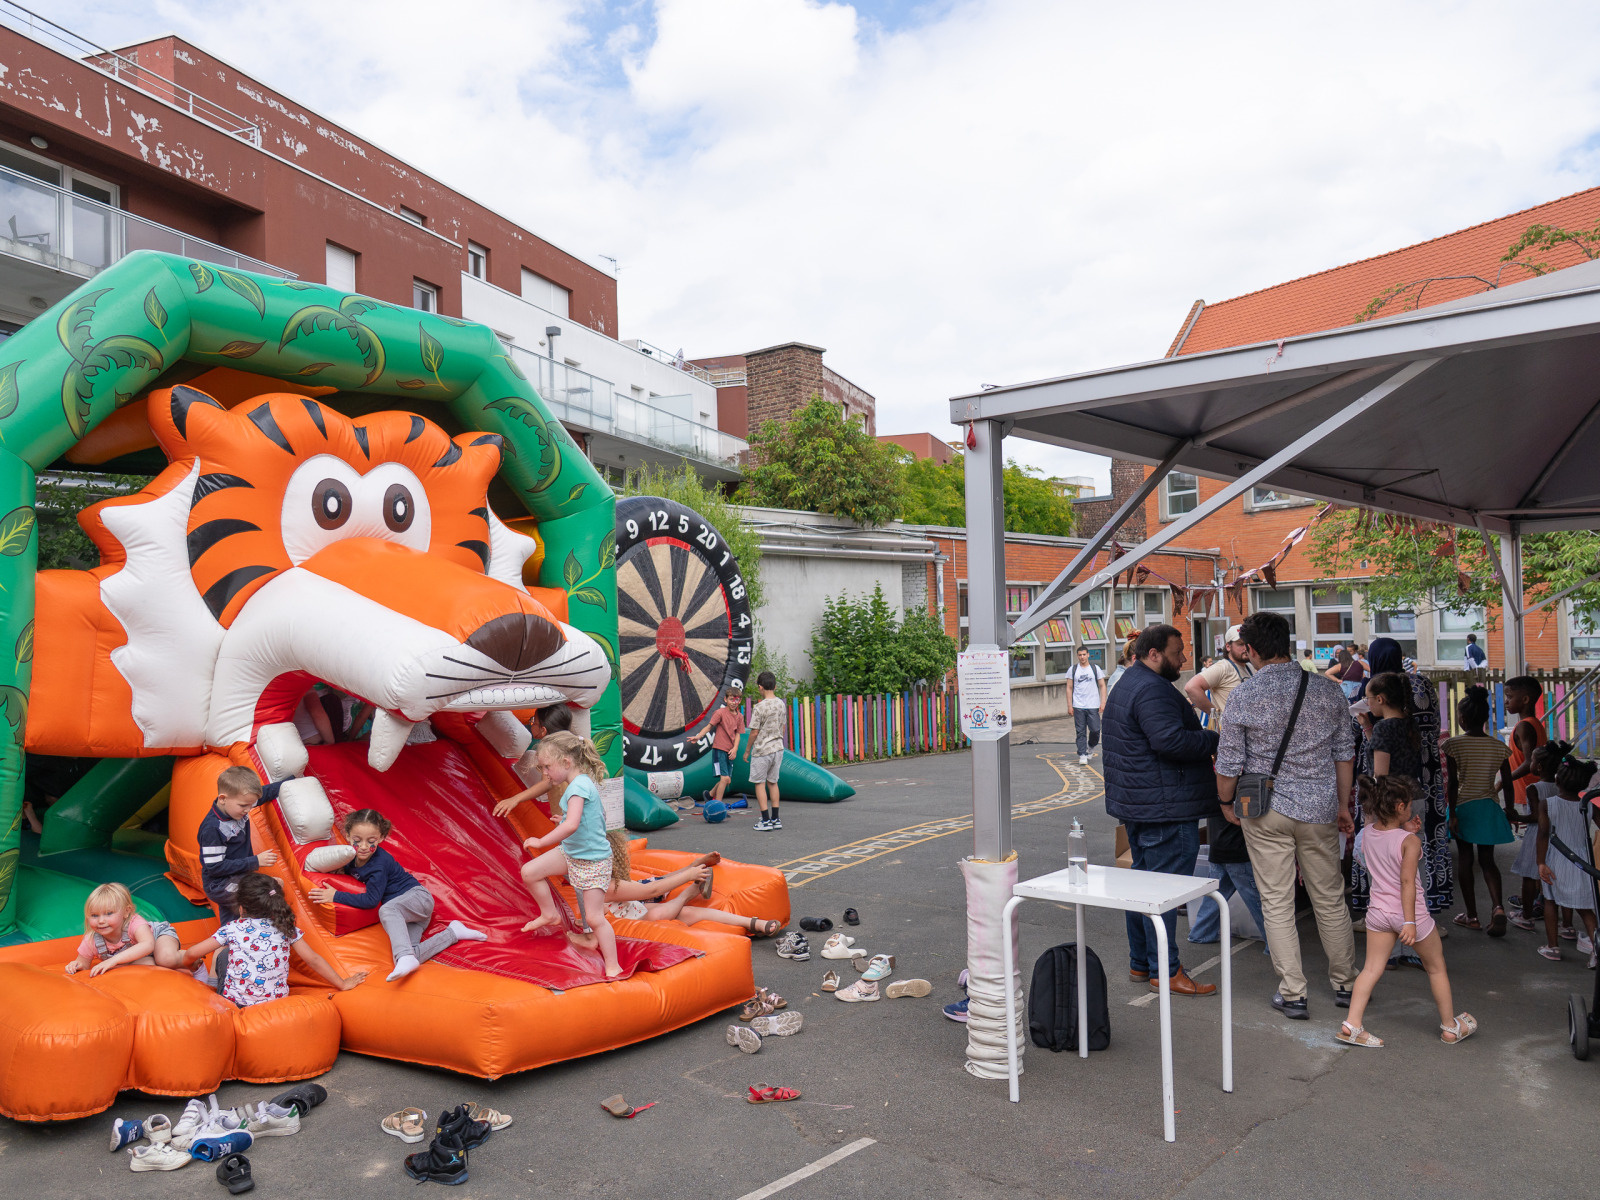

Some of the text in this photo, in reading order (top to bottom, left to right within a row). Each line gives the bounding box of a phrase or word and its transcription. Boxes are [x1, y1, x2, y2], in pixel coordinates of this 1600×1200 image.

[626, 519, 639, 539] 9
[648, 510, 669, 531] 12
[678, 514, 690, 533] 5
[696, 524, 717, 550] 20
[719, 551, 730, 567] 1
[729, 574, 745, 600] 18
[738, 613, 751, 629] 4
[737, 642, 751, 665] 13
[640, 745, 663, 766] 17
[673, 742, 688, 762] 2
